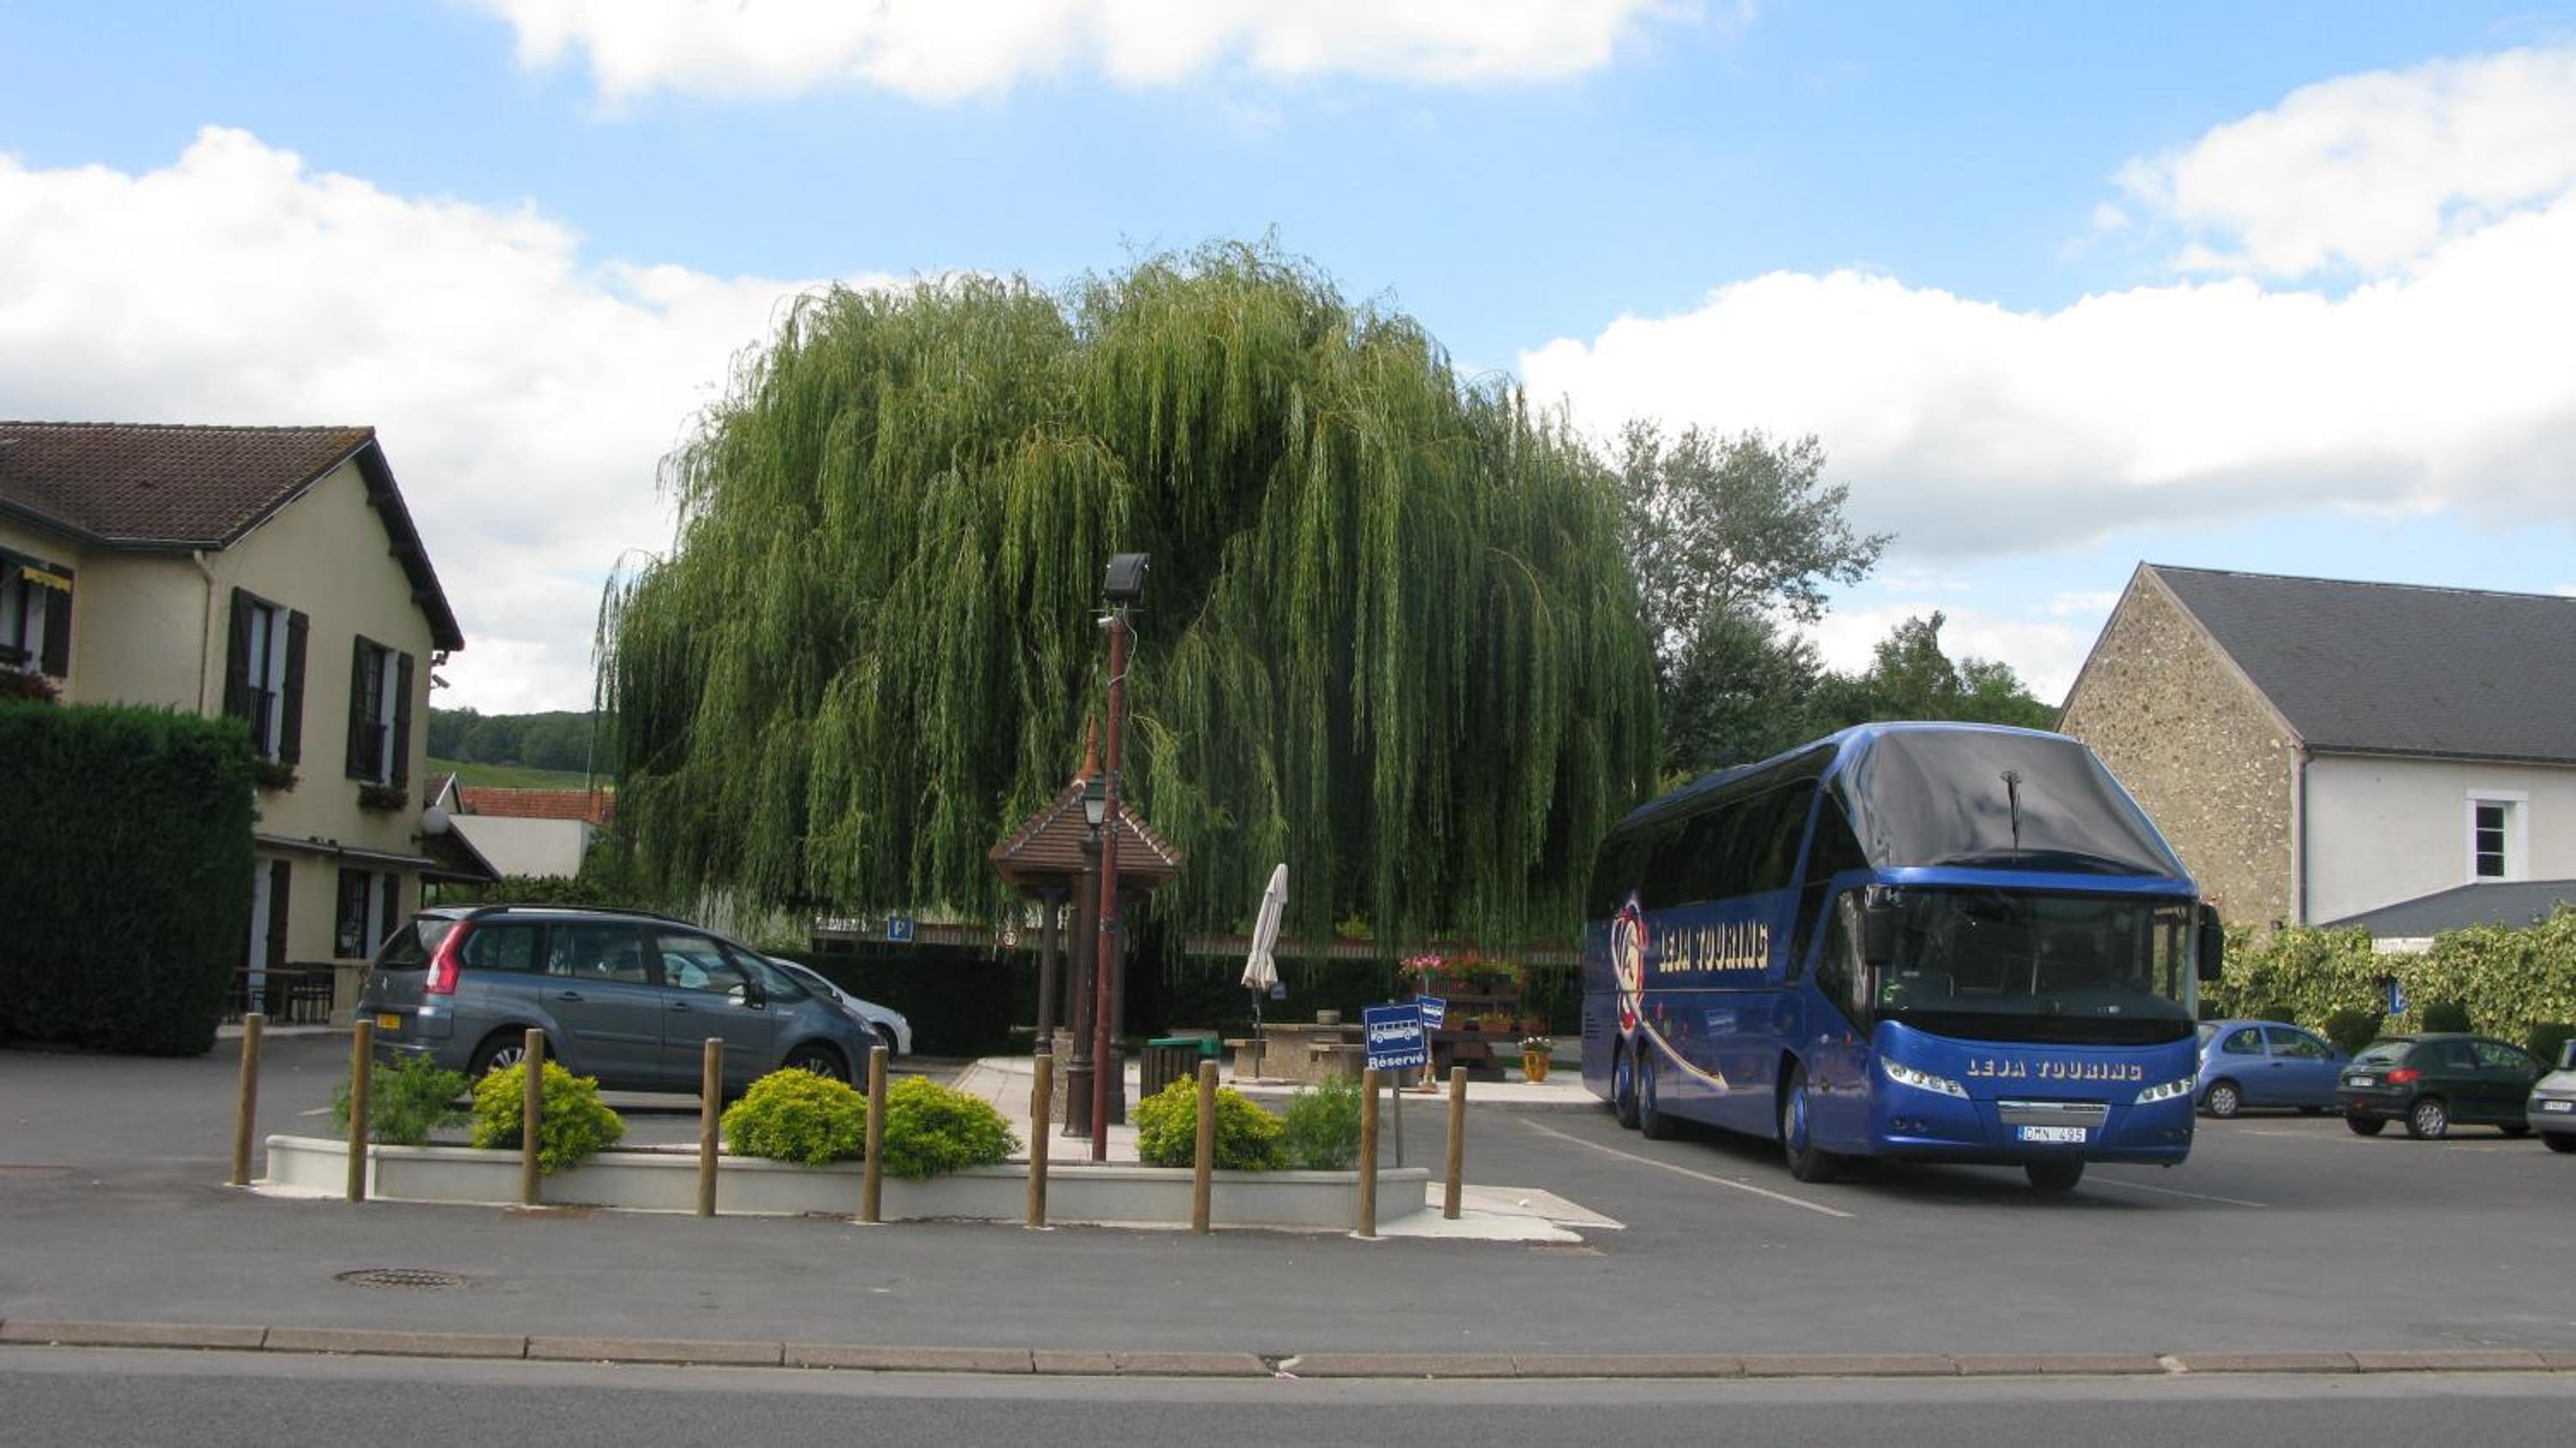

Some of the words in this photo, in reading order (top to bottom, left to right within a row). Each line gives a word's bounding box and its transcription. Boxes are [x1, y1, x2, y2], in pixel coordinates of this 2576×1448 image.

[1659, 928, 1691, 972] LEJA
[1697, 920, 1769, 971] TOURING
[1368, 1051, 1425, 1068] Réservé
[1967, 1058, 2026, 1077] LEJA
[2036, 1060, 2142, 1080] TOURING
